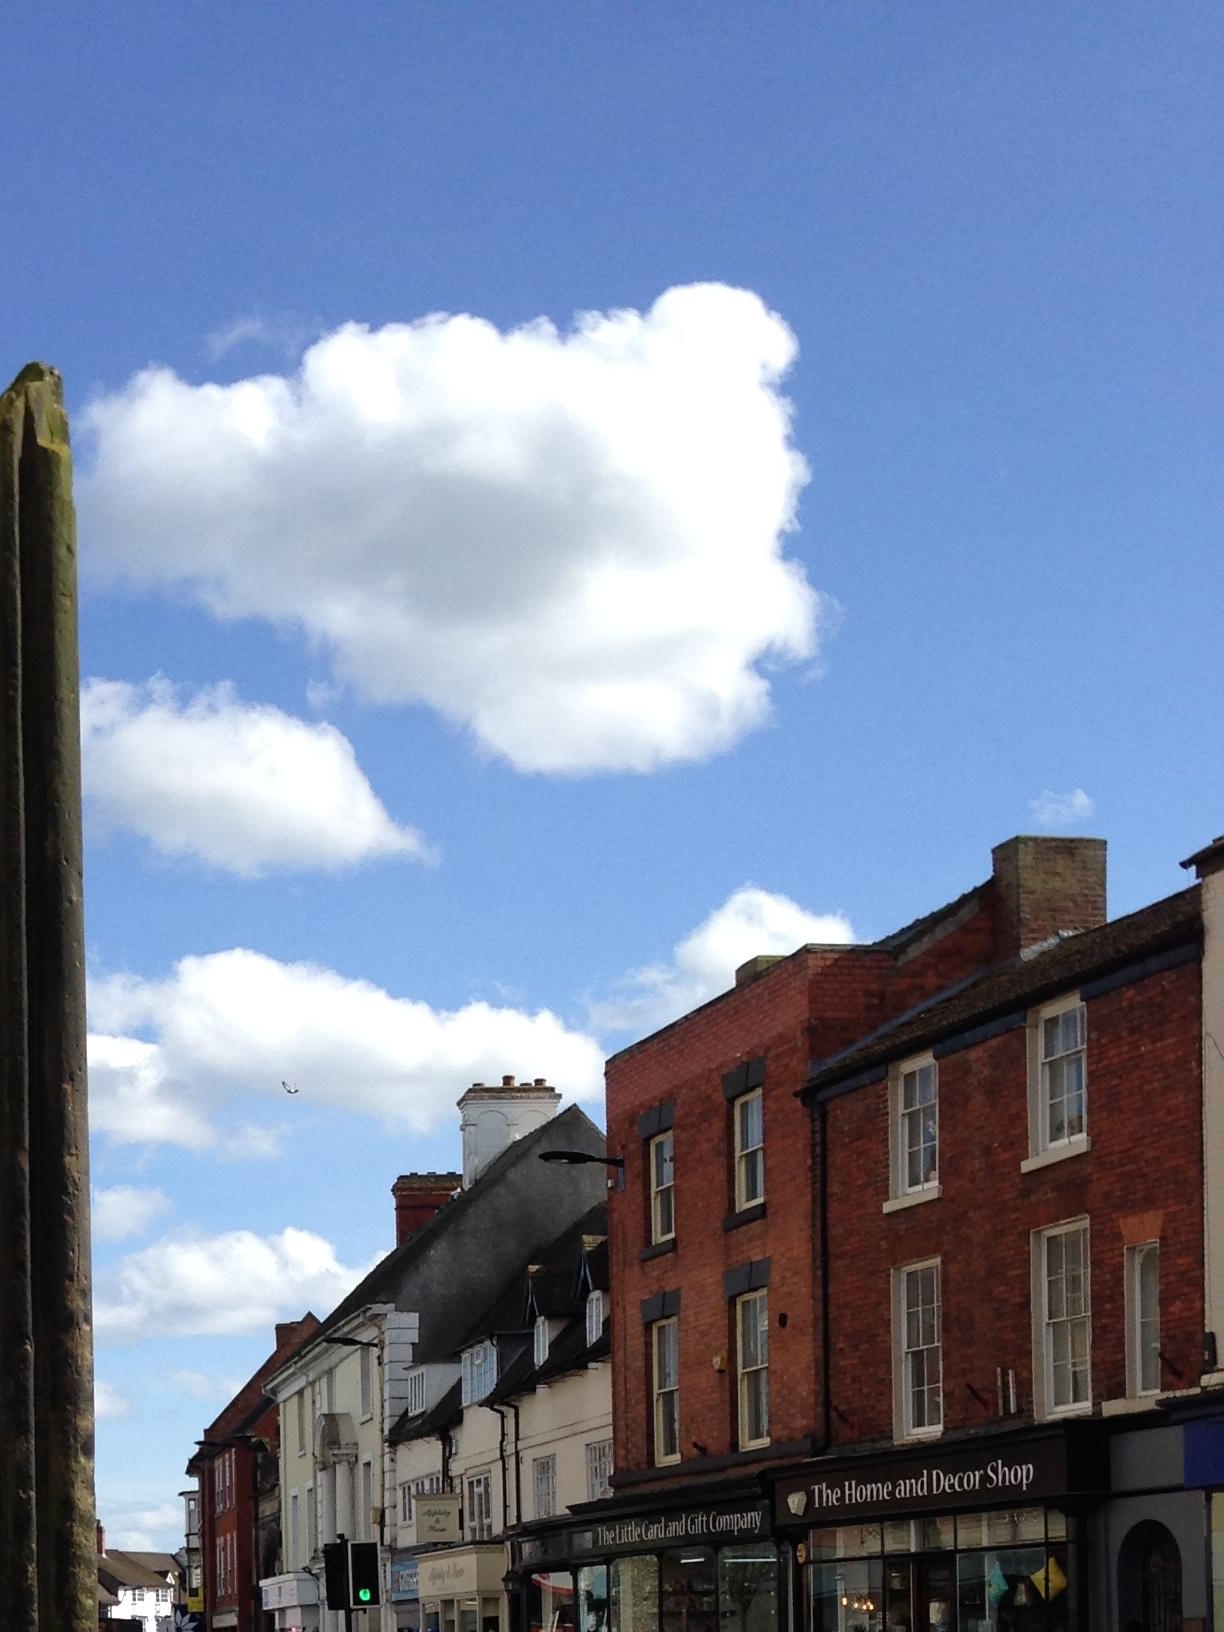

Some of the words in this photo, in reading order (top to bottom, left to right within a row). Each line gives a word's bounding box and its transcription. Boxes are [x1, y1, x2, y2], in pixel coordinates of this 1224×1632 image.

[810, 1482, 841, 1508] The
[844, 1480, 892, 1504] Home
[895, 1469, 927, 1498] and
[931, 1468, 983, 1495] Decor
[986, 1459, 1034, 1491] Shop
[598, 1526, 615, 1546] The
[615, 1520, 640, 1544] Little
[642, 1516, 665, 1540] Card
[666, 1513, 686, 1538] and
[687, 1511, 708, 1535] Gift
[709, 1510, 762, 1536] Company
